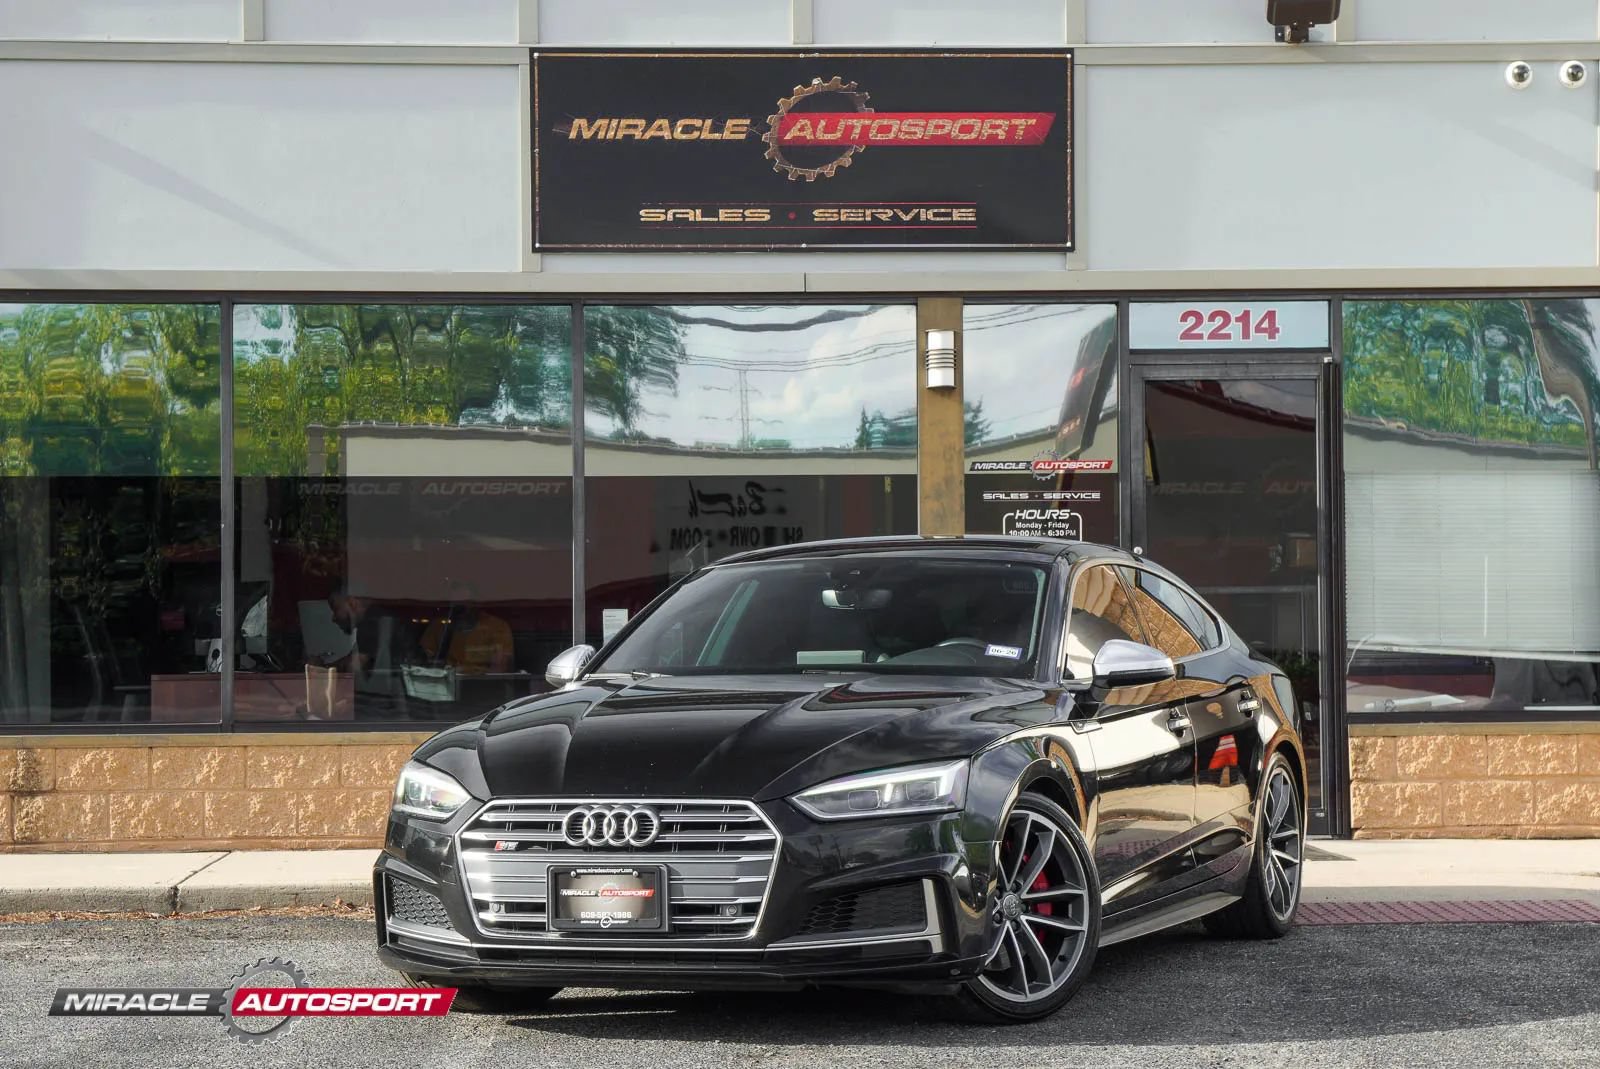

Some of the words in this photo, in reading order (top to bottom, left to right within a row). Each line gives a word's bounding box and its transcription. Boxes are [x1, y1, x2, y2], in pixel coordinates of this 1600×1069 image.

[568, 118, 752, 140] MIRACLE
[783, 118, 1037, 141] AUTOSPORT
[639, 207, 772, 222] SALES
[812, 207, 978, 222] SERVICE
[1179, 308, 1281, 341] 2214
[974, 461, 1027, 471] MIRACLE
[1035, 460, 1110, 470] AUTOSPORT
[298, 482, 401, 495] MIRACLE
[421, 482, 567, 495] AUTOSPORT
[982, 492, 1029, 500] SALES
[1015, 509, 1071, 520] HOURS
[1015, 521, 1042, 530] Monday
[1048, 521, 1070, 530] Friday
[1009, 529, 1030, 537] 10:00
[1047, 529, 1065, 537] 6:30
[1065, 529, 1077, 537] PM
[562, 889, 597, 897] MIRACLE
[601, 889, 651, 897] AUTOSPORT
